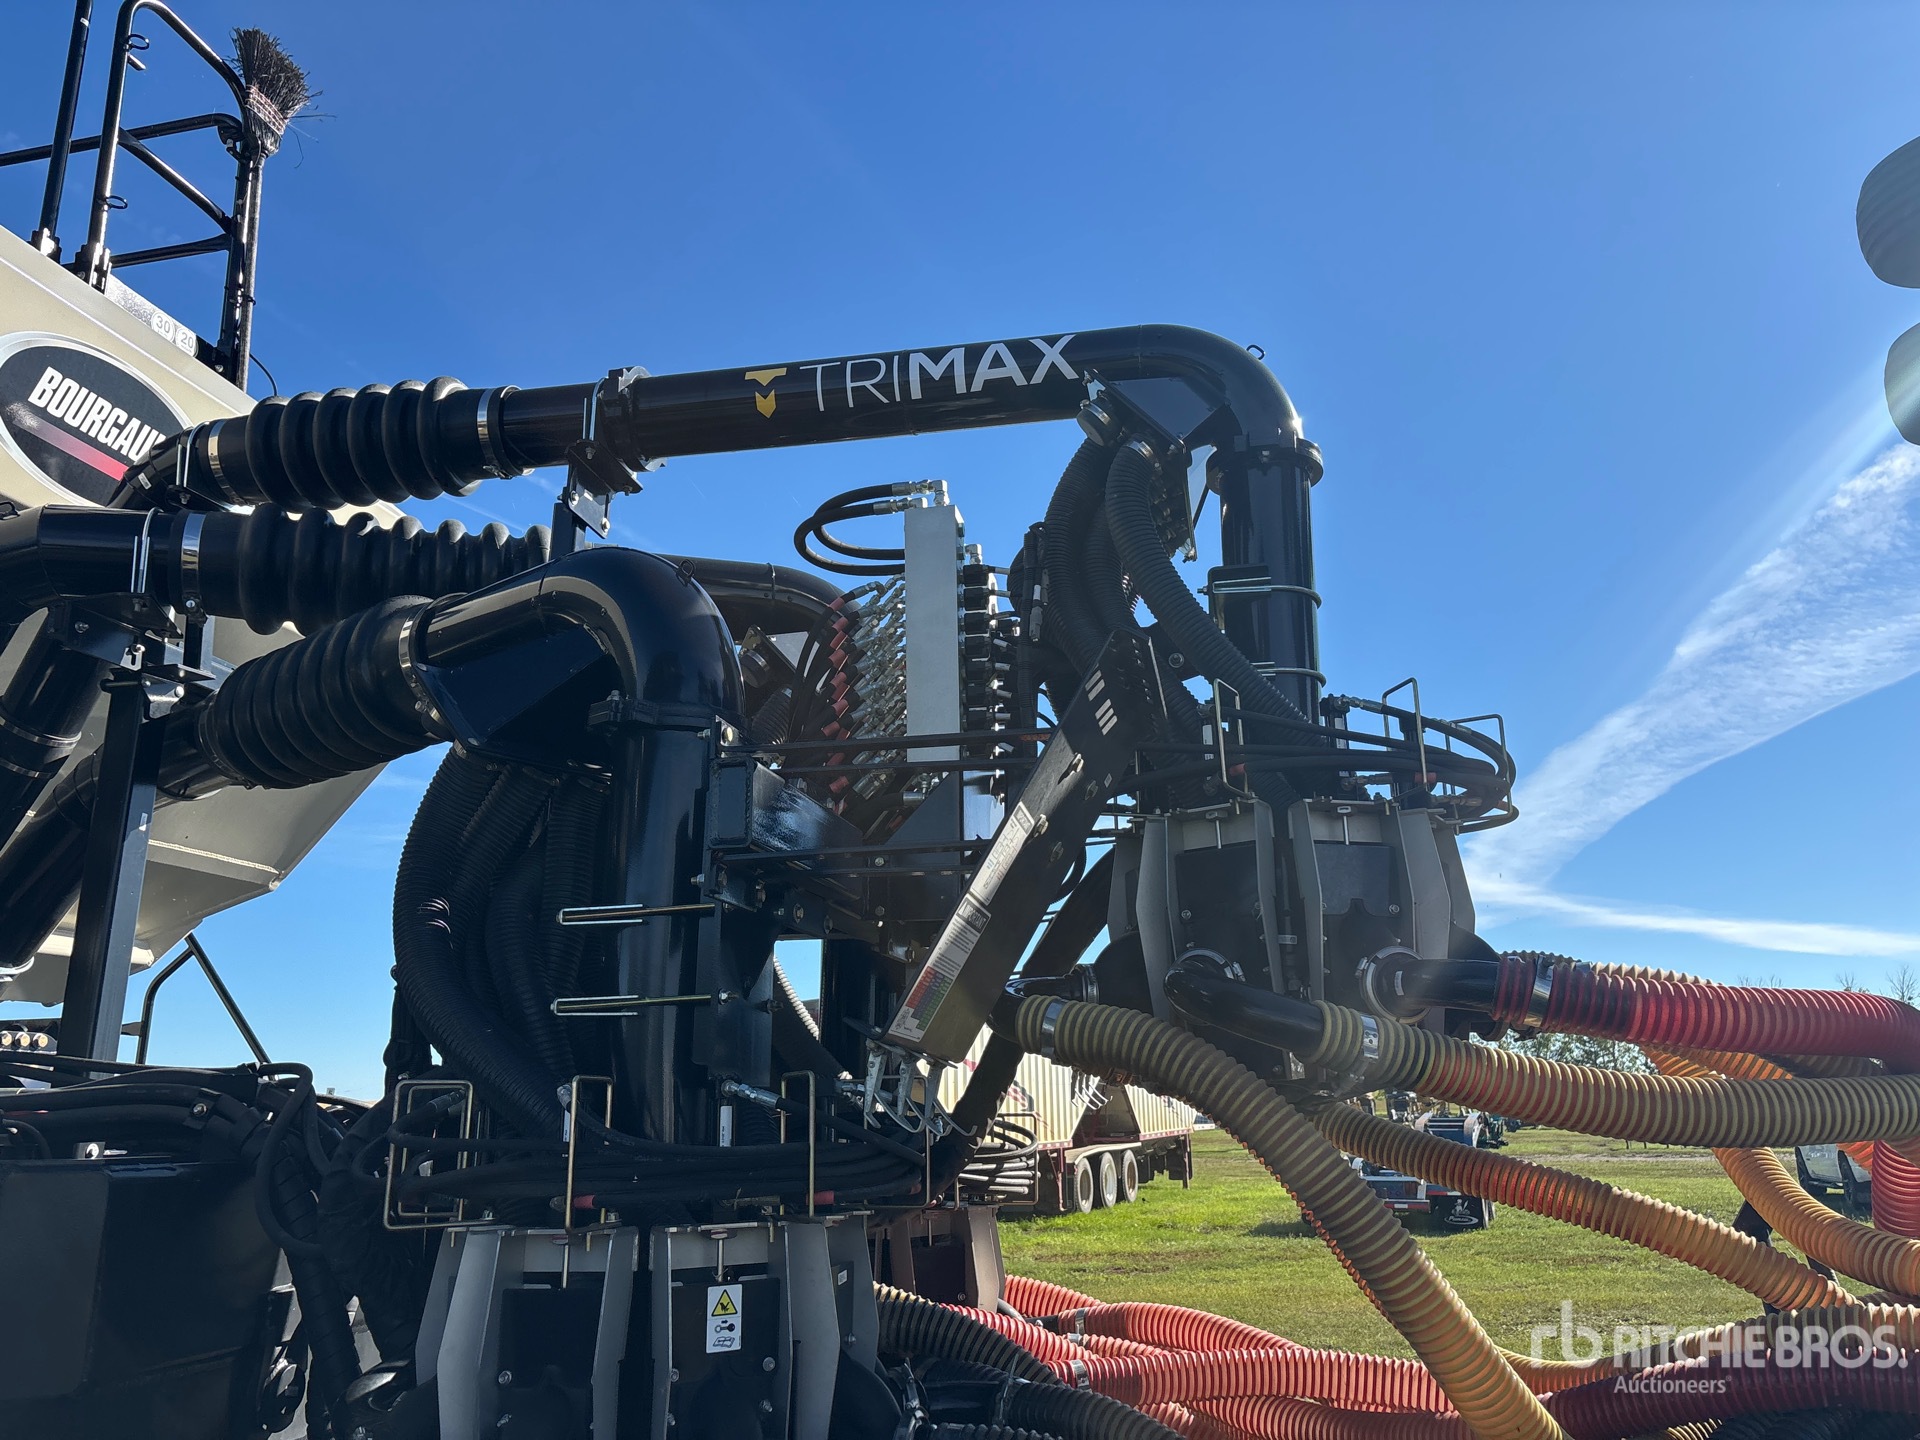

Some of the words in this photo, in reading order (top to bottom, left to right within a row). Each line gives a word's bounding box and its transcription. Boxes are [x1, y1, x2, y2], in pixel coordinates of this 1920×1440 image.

[156, 315, 171, 334] 30
[180, 332, 194, 349] 20
[798, 334, 1080, 412] TRIMAX
